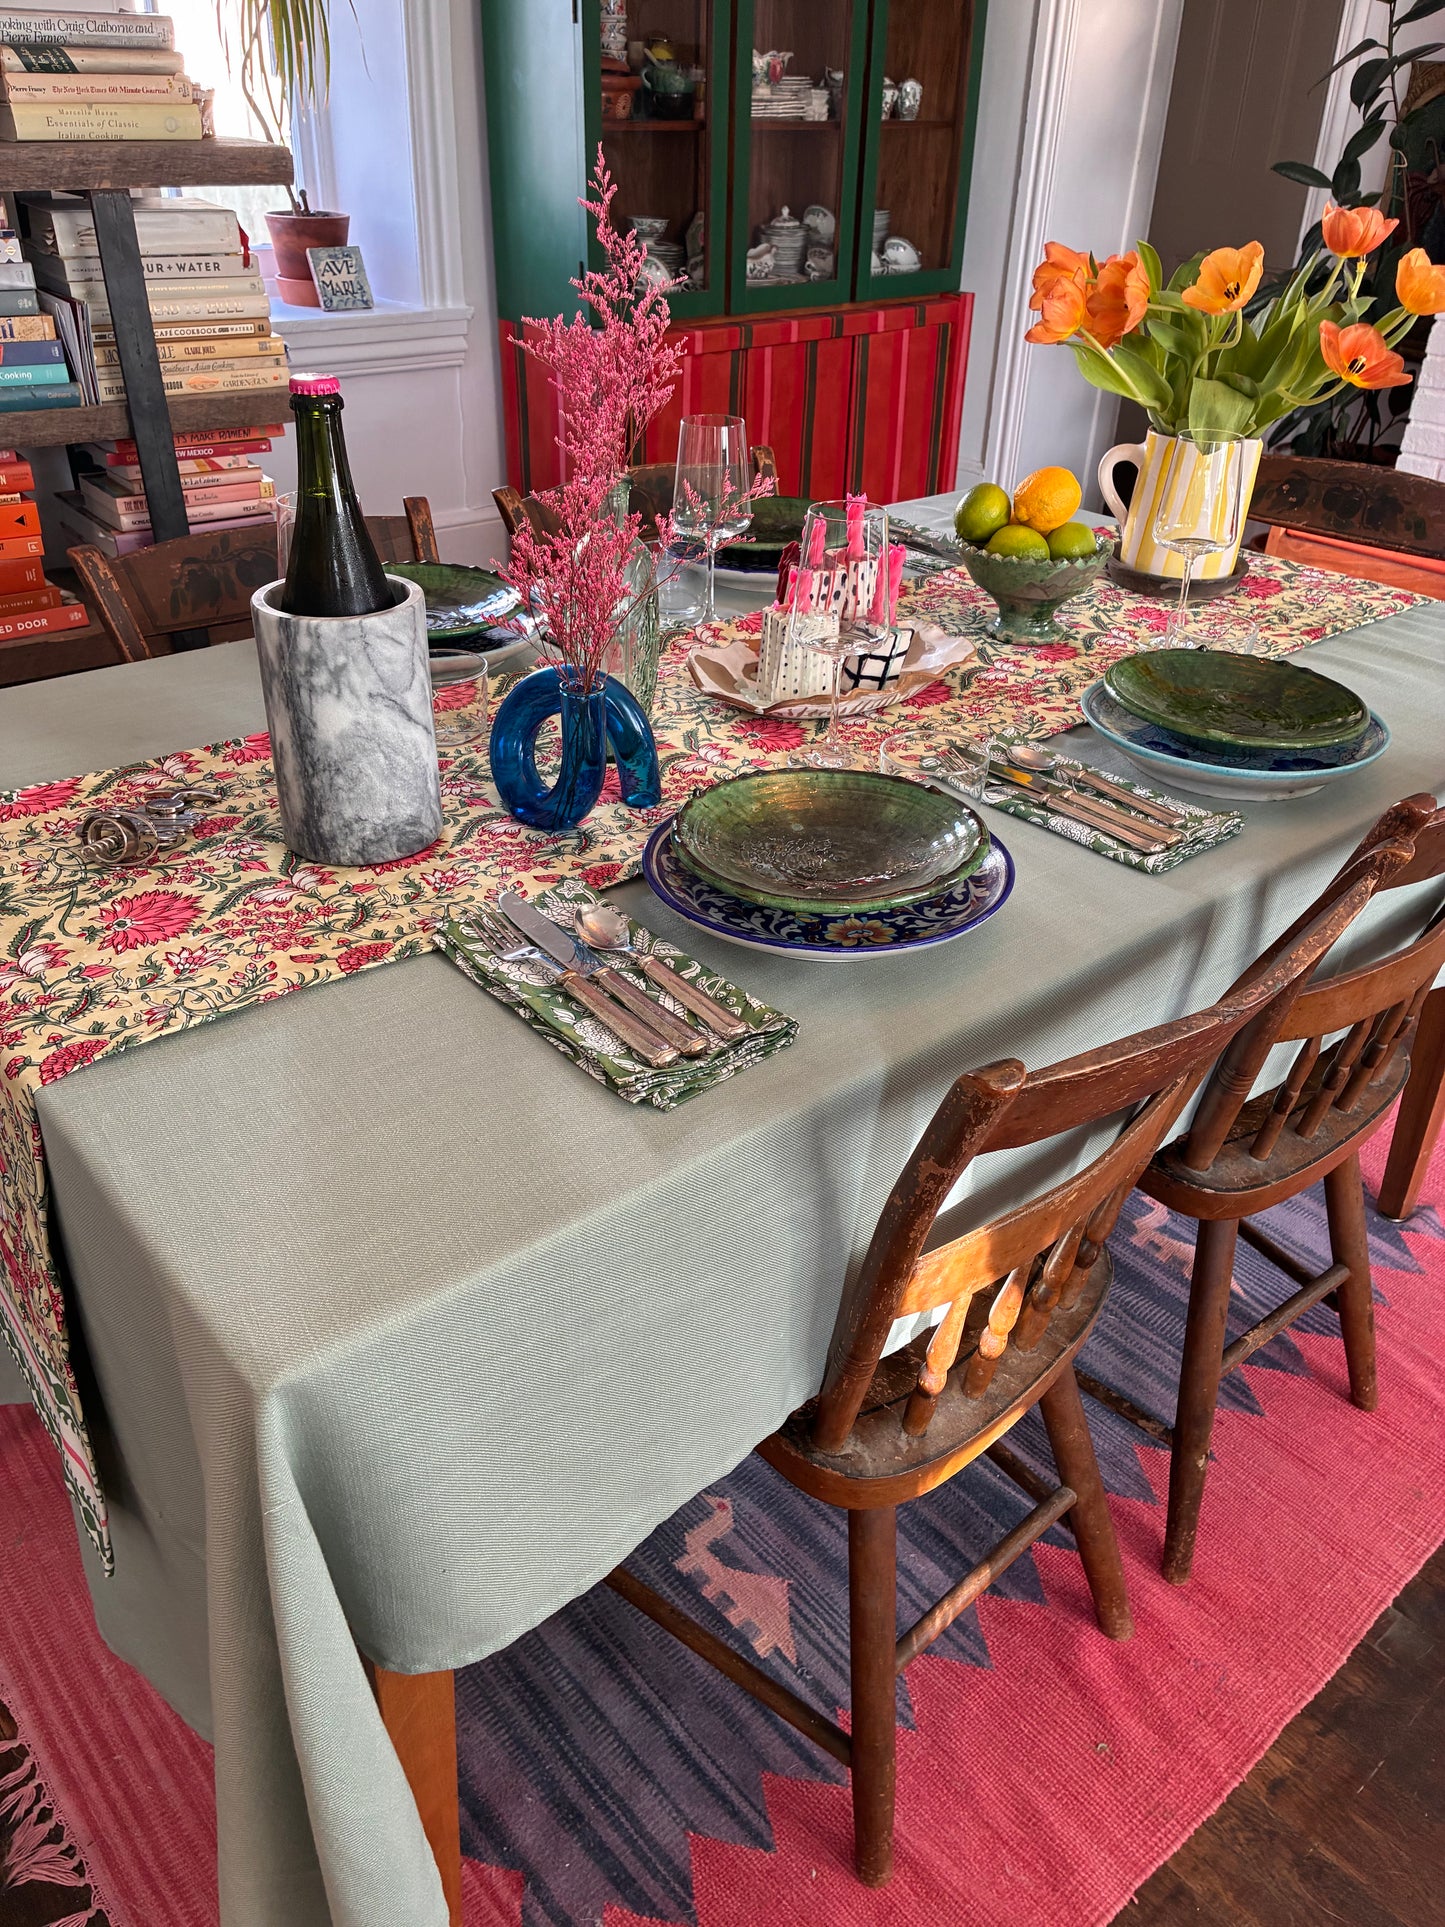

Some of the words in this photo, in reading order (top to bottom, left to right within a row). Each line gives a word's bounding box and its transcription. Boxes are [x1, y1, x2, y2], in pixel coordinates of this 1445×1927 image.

[34, 18, 56, 32] with
[57, 19, 85, 34] Craig
[86, 20, 134, 34] Claiborne
[135, 22, 154, 34] and
[1, 30, 31, 43] Pierre
[34, 31, 68, 44] Franey
[10, 85, 27, 93] Pierre
[28, 85, 46, 94] Franey
[52, 86, 62, 94] The
[64, 86, 75, 94] New
[76, 86, 90, 95] York
[90, 86, 107, 94] Times
[120, 86, 141, 94] Minute
[142, 86, 168, 94] Gourmet
[46, 116, 94, 128] Essentials
[96, 119, 106, 130] of
[108, 119, 140, 128] Classic
[58, 131, 86, 139] Italian
[88, 131, 124, 140] Cooking
[176, 262, 222, 273] WATER
[321, 260, 358, 276] AVE
[174, 326, 218, 336] COOKBOOK
[190, 432, 215, 442] MAKE
[186, 448, 214, 457] MEXICO
[17, 618, 48, 631] DOOR
